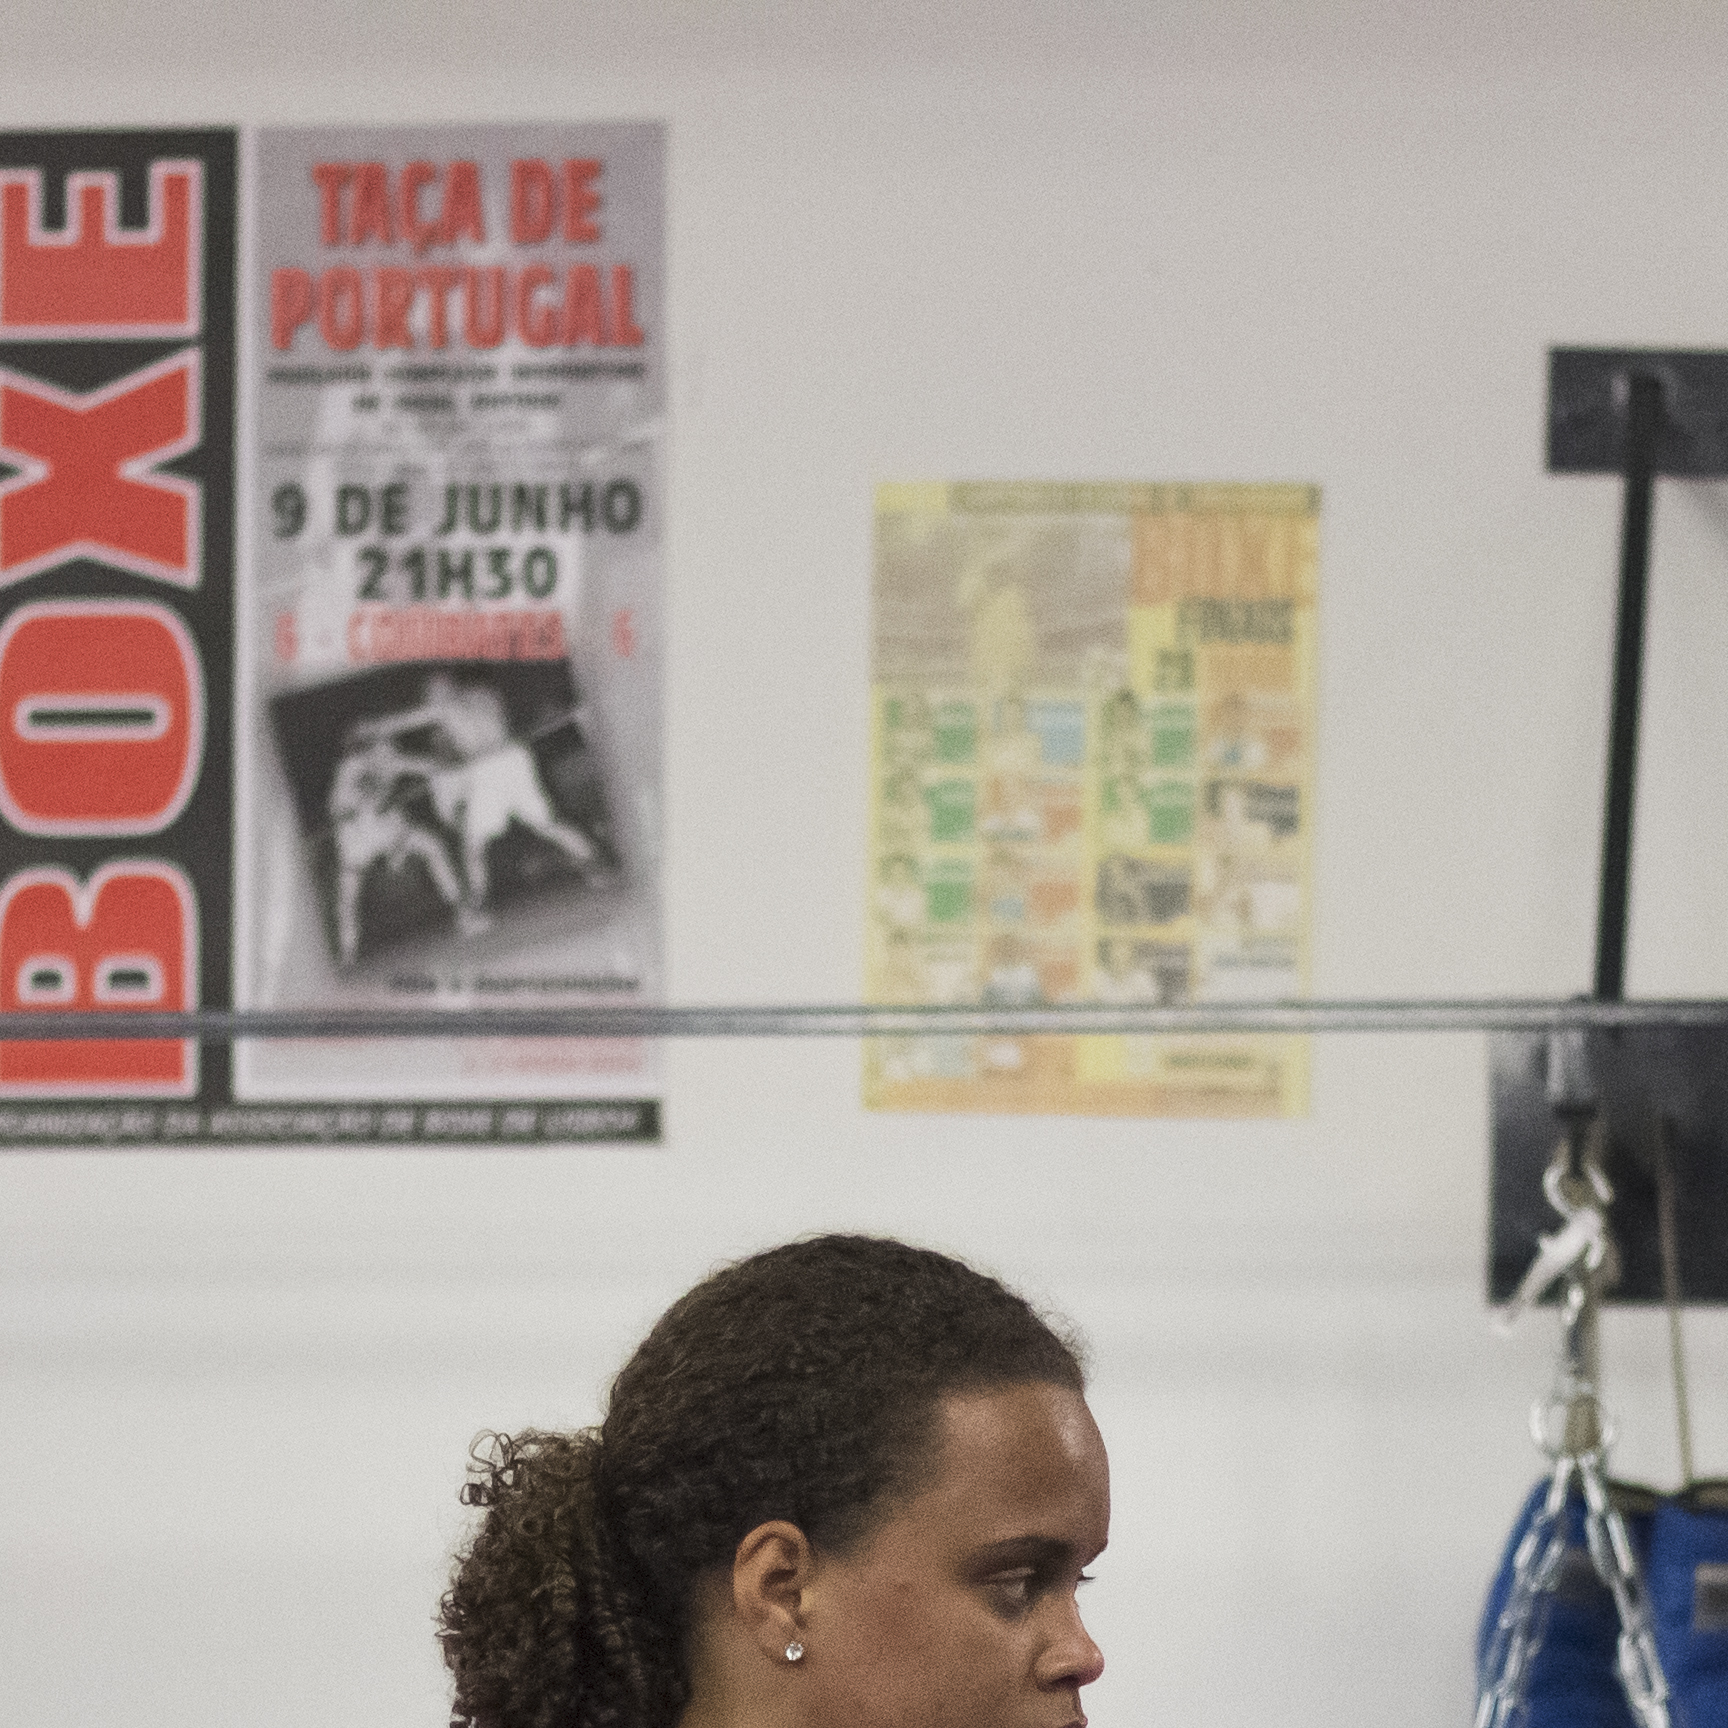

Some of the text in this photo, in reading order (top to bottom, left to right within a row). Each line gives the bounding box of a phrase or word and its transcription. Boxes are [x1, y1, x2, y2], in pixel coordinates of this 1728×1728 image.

[312, 158, 603, 256] TAÇA DE
[271, 265, 643, 350] PORTUGAL
[272, 479, 644, 540] 9 DE JUNHO
[356, 545, 559, 600] 21H30
